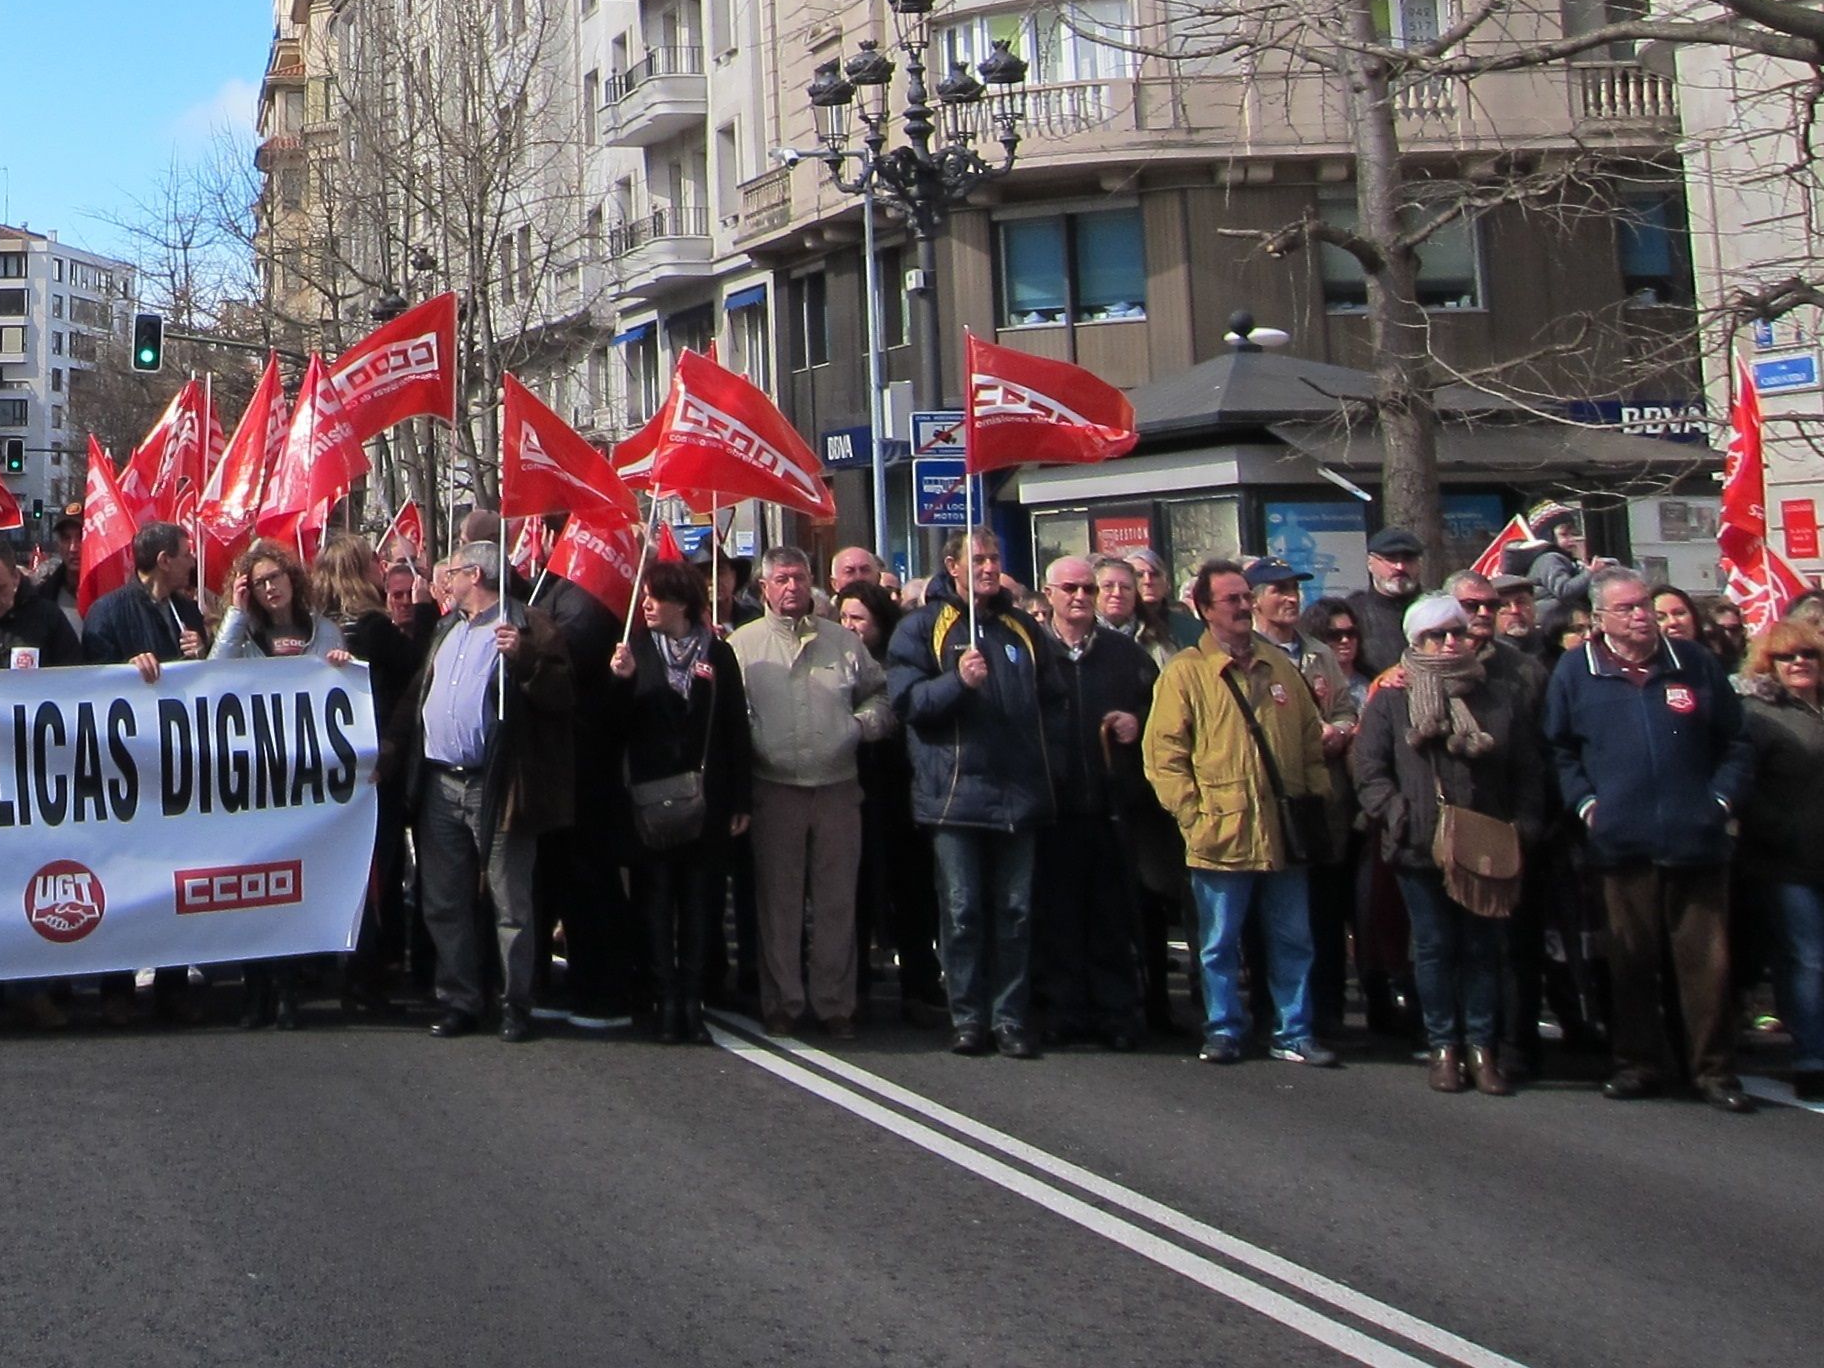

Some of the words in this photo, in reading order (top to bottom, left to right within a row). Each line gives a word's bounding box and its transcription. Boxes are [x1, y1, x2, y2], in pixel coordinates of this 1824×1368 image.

[1621, 406, 1709, 434] BBVA
[827, 434, 853, 460] BBVA
[157, 686, 358, 817] DIGNAS
[34, 872, 93, 911] UGT
[183, 869, 294, 905] CCOO
